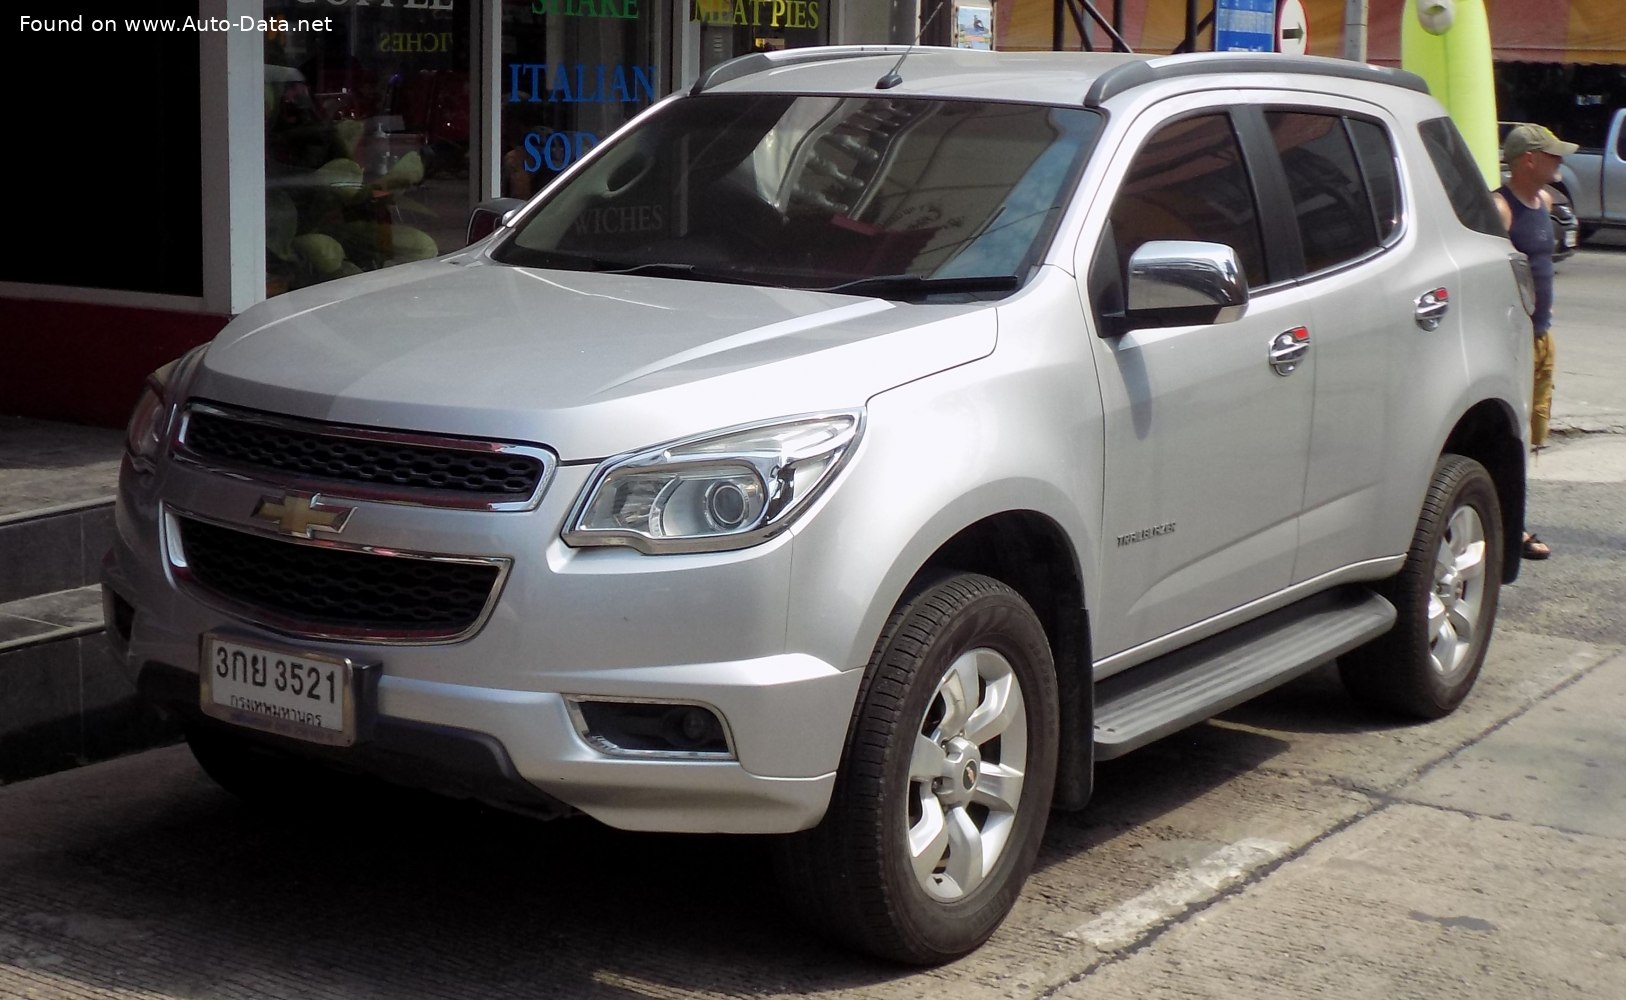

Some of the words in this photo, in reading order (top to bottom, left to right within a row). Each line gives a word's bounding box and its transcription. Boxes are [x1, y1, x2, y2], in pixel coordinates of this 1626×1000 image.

[691, 0, 766, 26] MEAT
[767, 0, 819, 29] PIES
[509, 63, 657, 104] ITALIAN
[523, 132, 600, 173] SOD
[216, 646, 267, 687] 3กย
[274, 660, 335, 704] 3521
[230, 694, 322, 728] กรงเทพมหานคร
